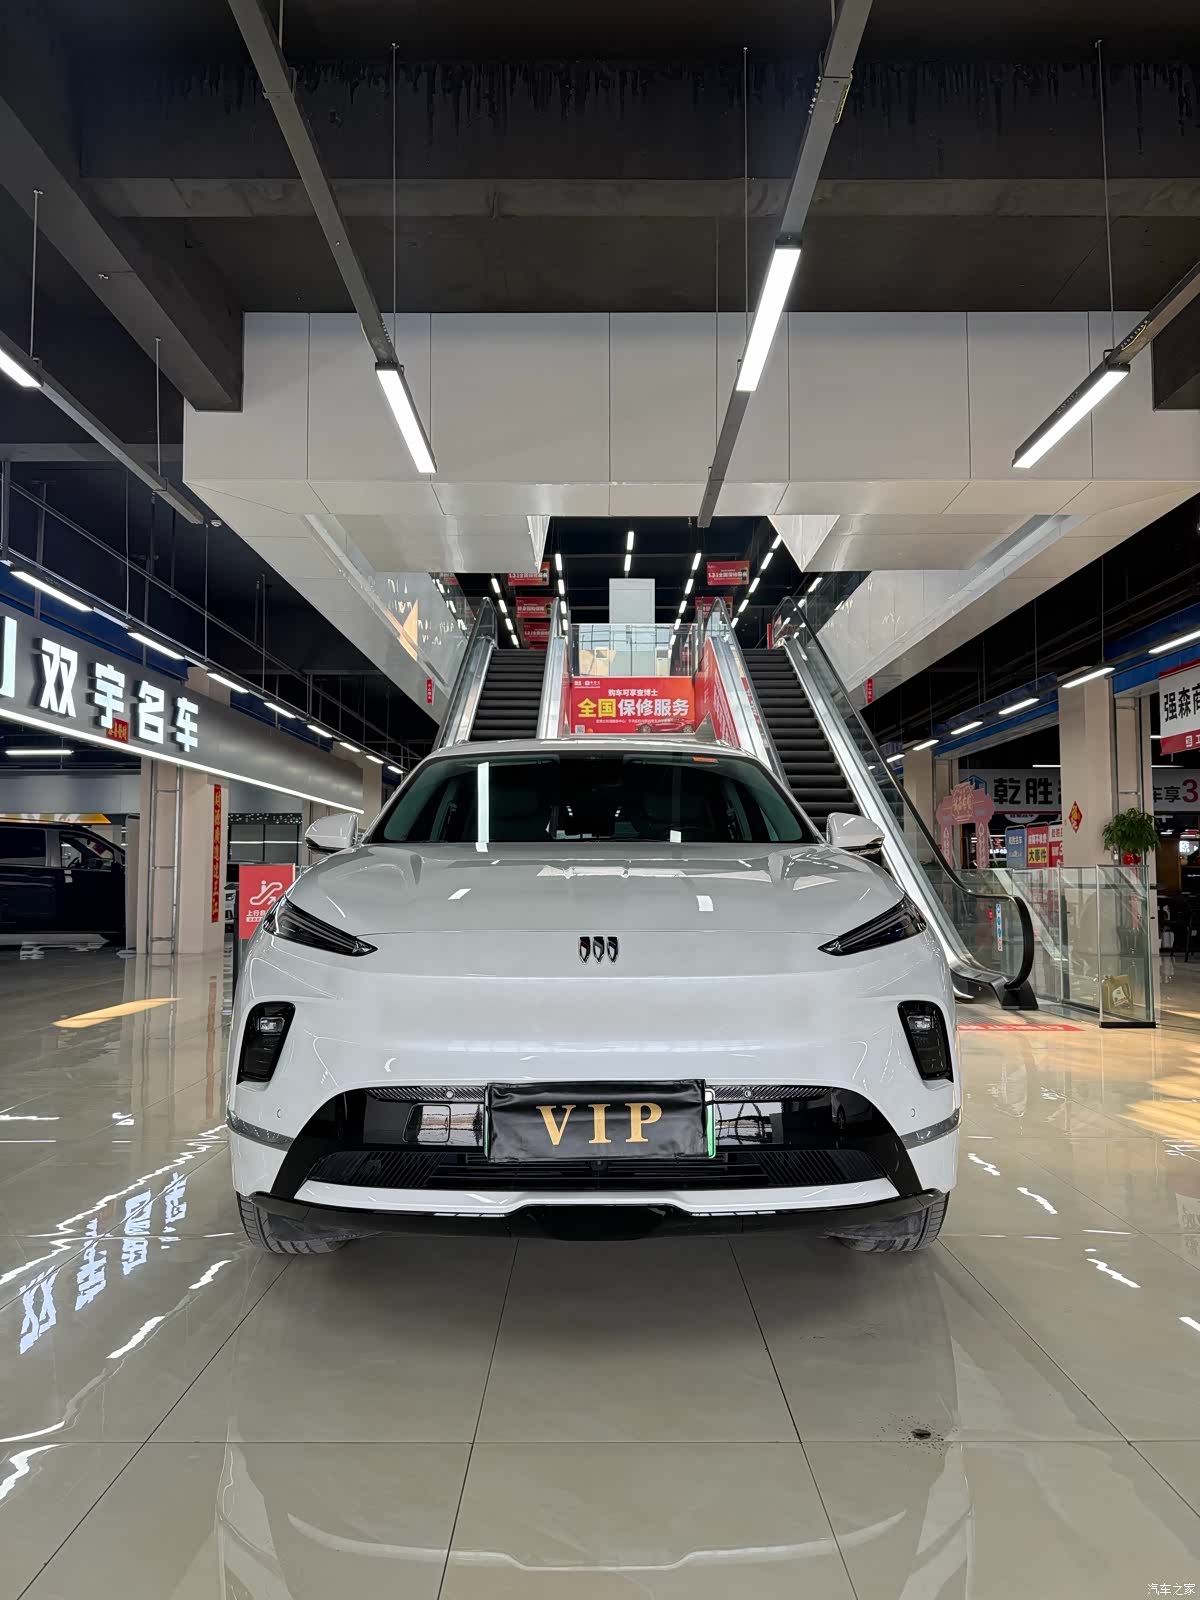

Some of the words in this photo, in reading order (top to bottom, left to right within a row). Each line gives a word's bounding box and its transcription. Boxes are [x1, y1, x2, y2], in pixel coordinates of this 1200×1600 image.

[577, 697, 690, 718] 全国保修服务
[993, 777, 1062, 805] 乾胜
[1028, 849, 1047, 862] 大事件
[246, 909, 267, 917] 上行自
[535, 1101, 663, 1146] VIP
